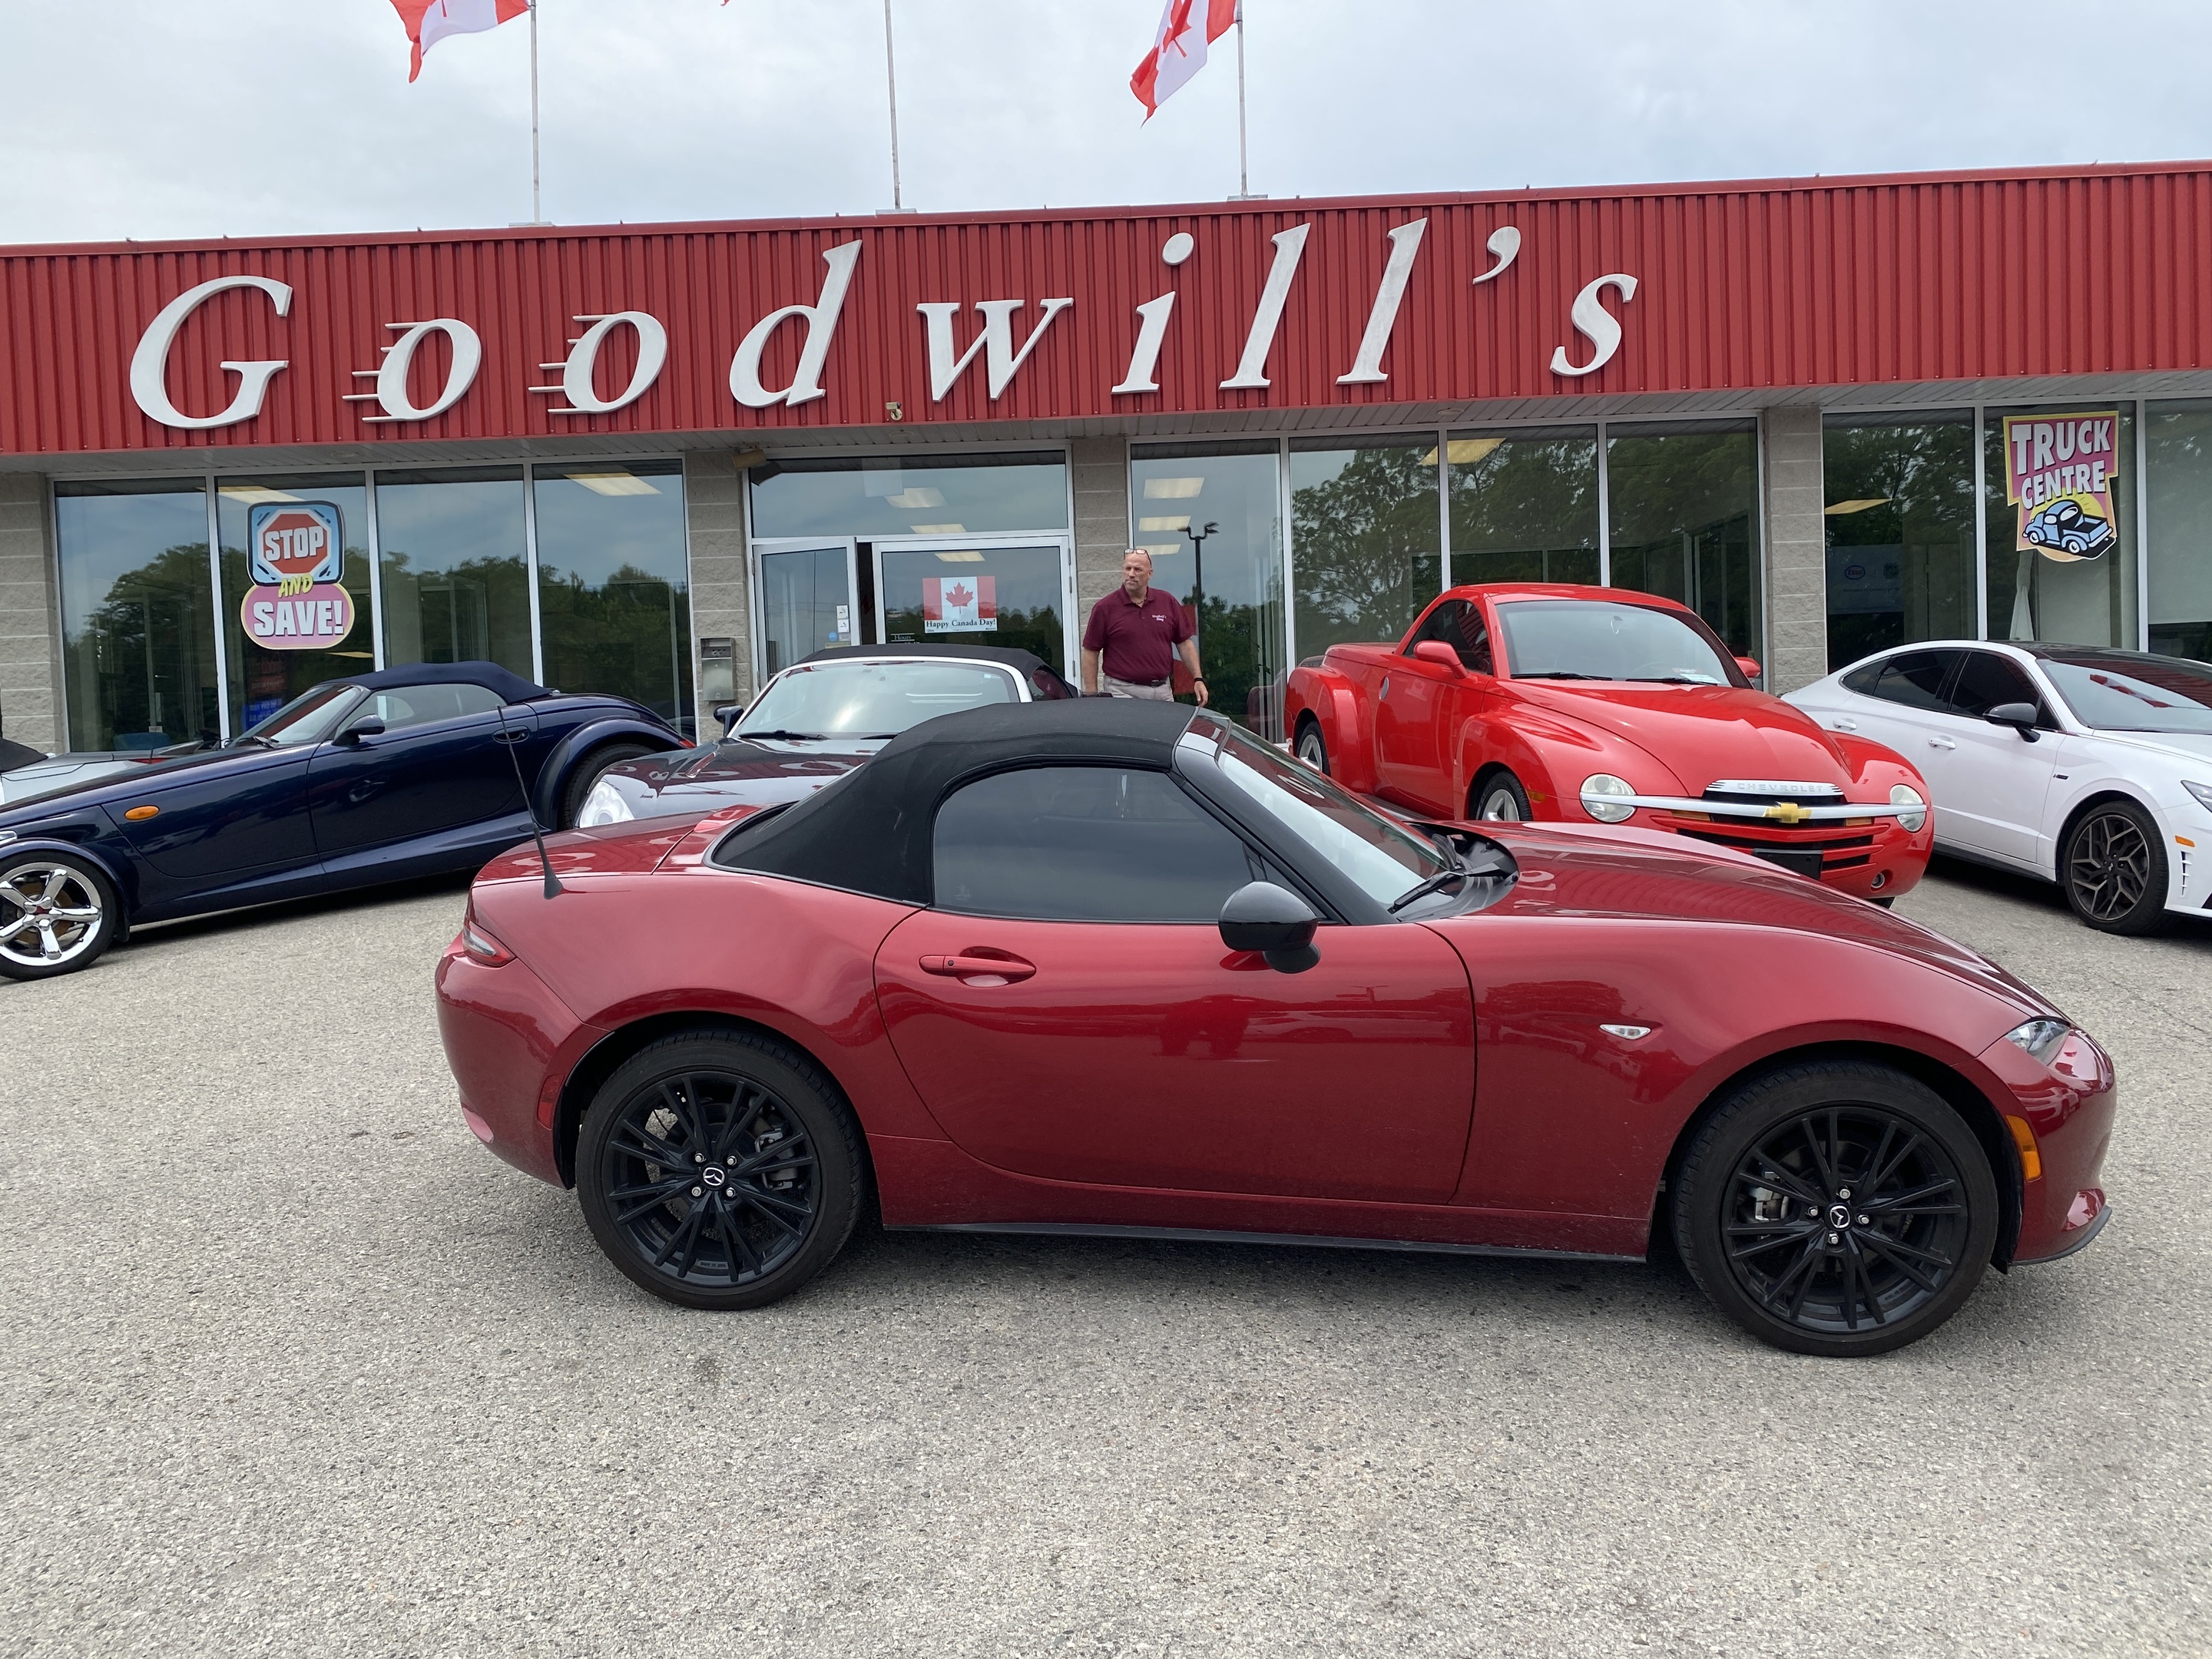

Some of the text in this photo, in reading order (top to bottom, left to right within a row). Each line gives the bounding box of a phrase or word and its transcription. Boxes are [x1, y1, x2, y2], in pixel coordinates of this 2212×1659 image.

[128, 217, 1639, 429] Goodwill's
[2012, 419, 2111, 475] TRUCK
[2021, 460, 2106, 510] CENTRE
[264, 525, 324, 562] STOP
[278, 574, 313, 598] AND
[253, 600, 345, 637] SAVE!
[926, 621, 949, 629] Happy
[979, 618, 996, 627] Day!
[1737, 783, 1823, 793] CHEVROLET
